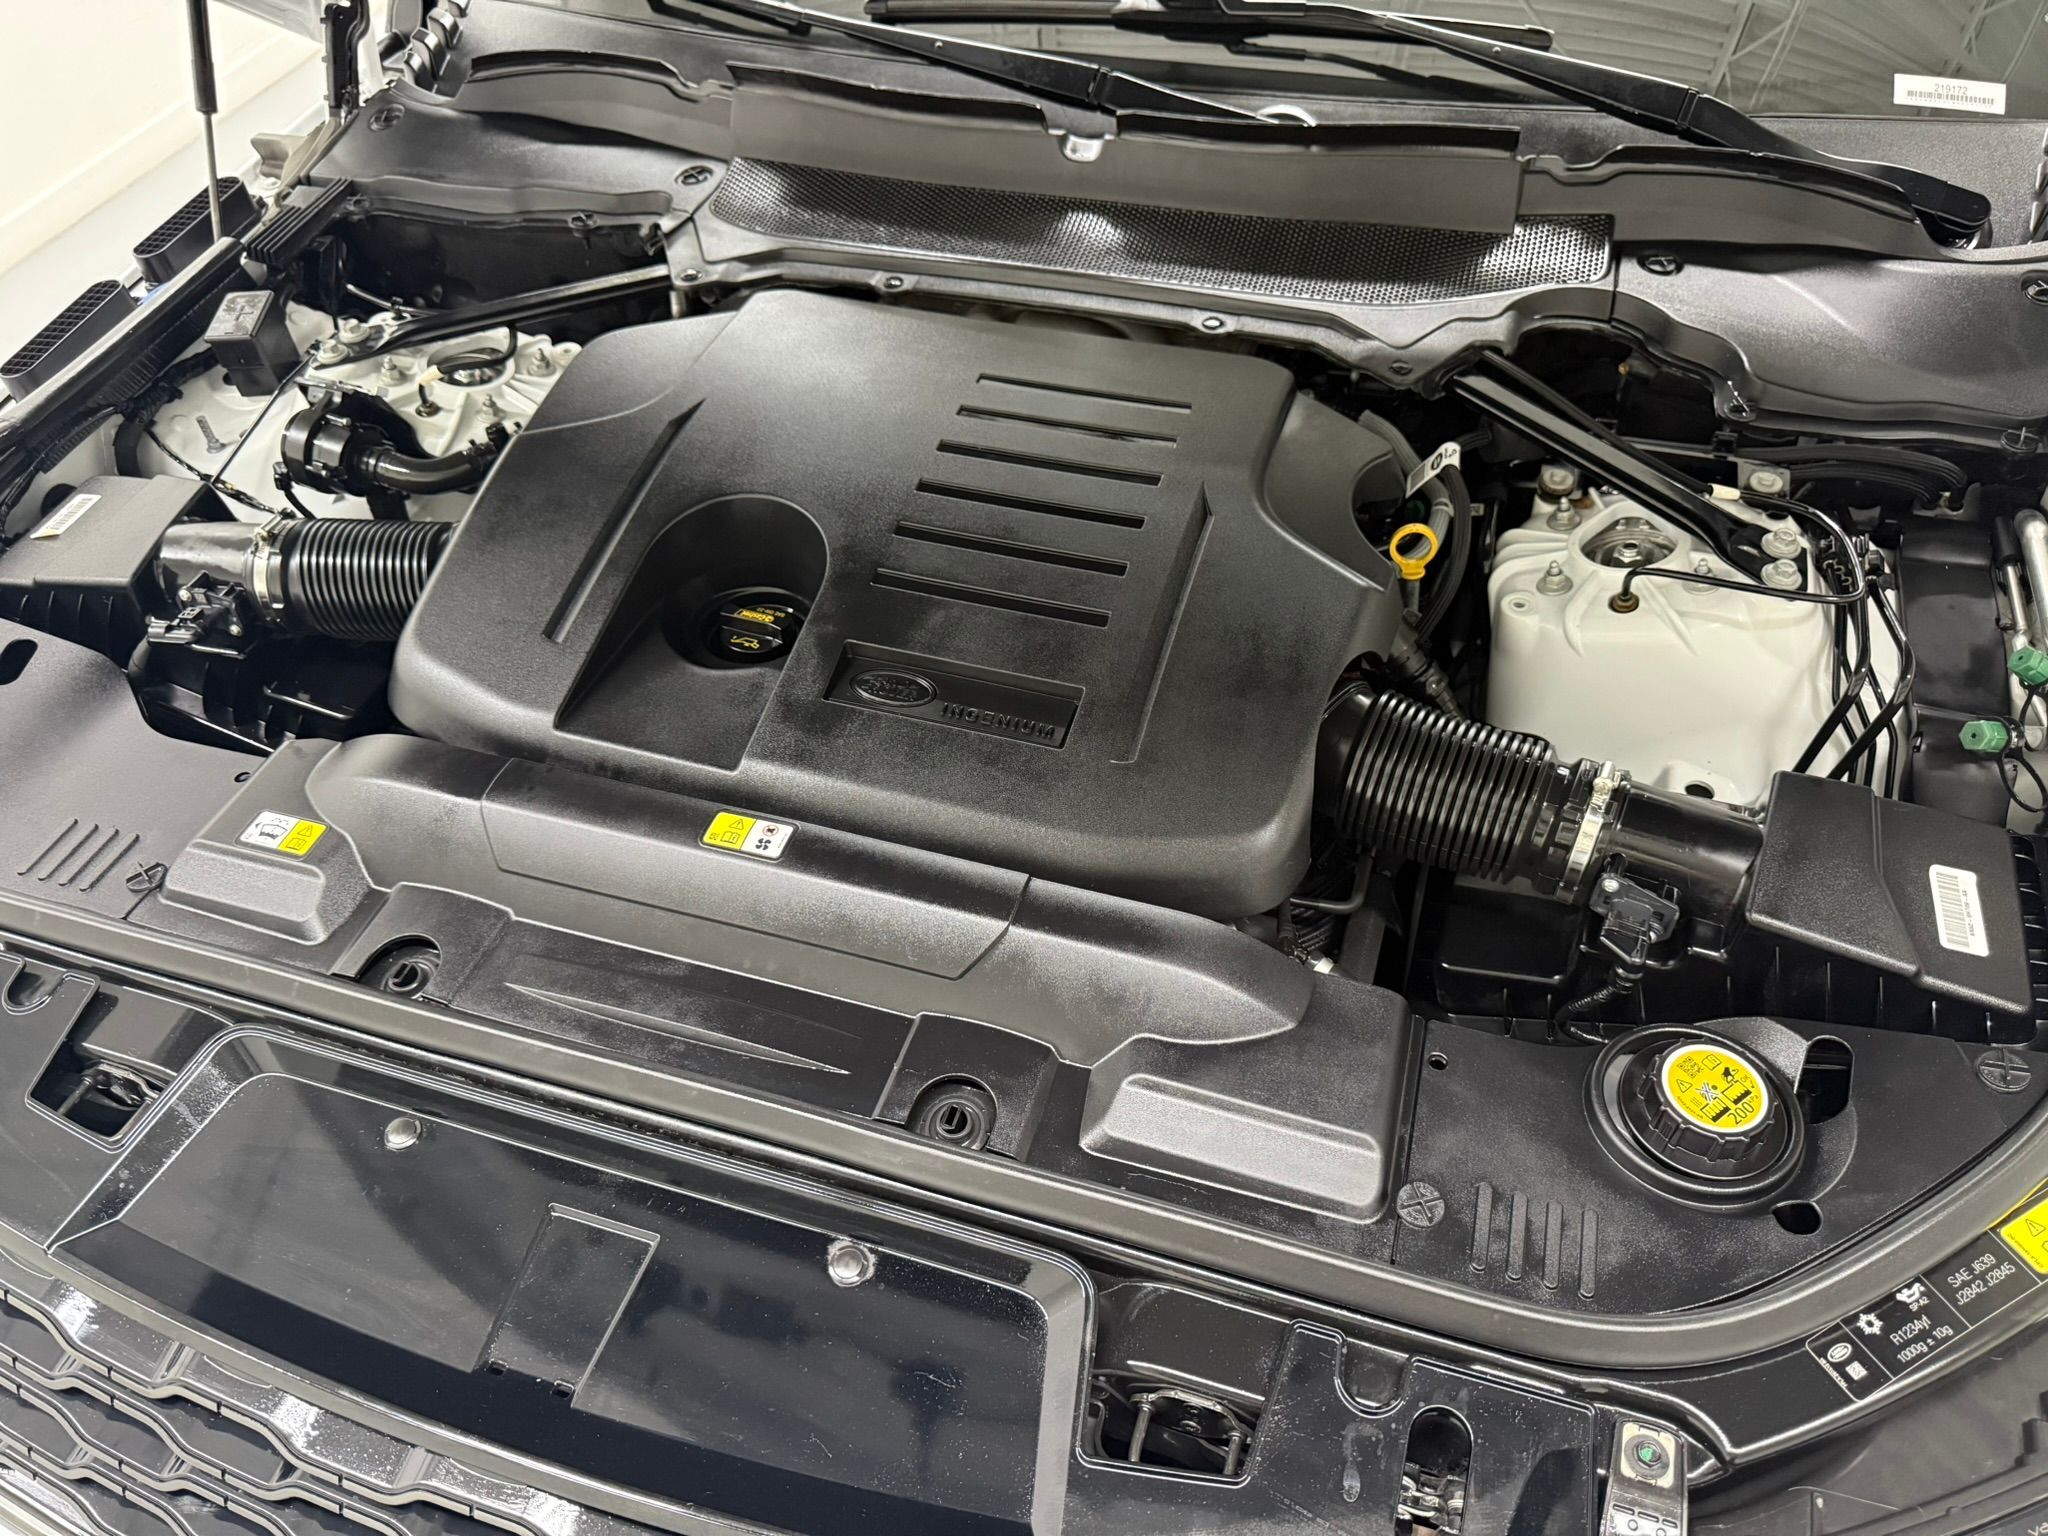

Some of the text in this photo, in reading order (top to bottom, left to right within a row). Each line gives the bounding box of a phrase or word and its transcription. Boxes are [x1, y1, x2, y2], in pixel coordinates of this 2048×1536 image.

[1934, 83, 1968, 95] 219172
[940, 702, 1056, 740] INGENIUM
[1727, 1101, 1755, 1125] 200
[1947, 1253, 1996, 1287] SAE J639
[1956, 1261, 2016, 1305] J2842 J2845
[1889, 1314, 1932, 1346] R1234yf
[1897, 1341, 1928, 1363] 1000g
[1932, 1325, 1954, 1340] 10g
